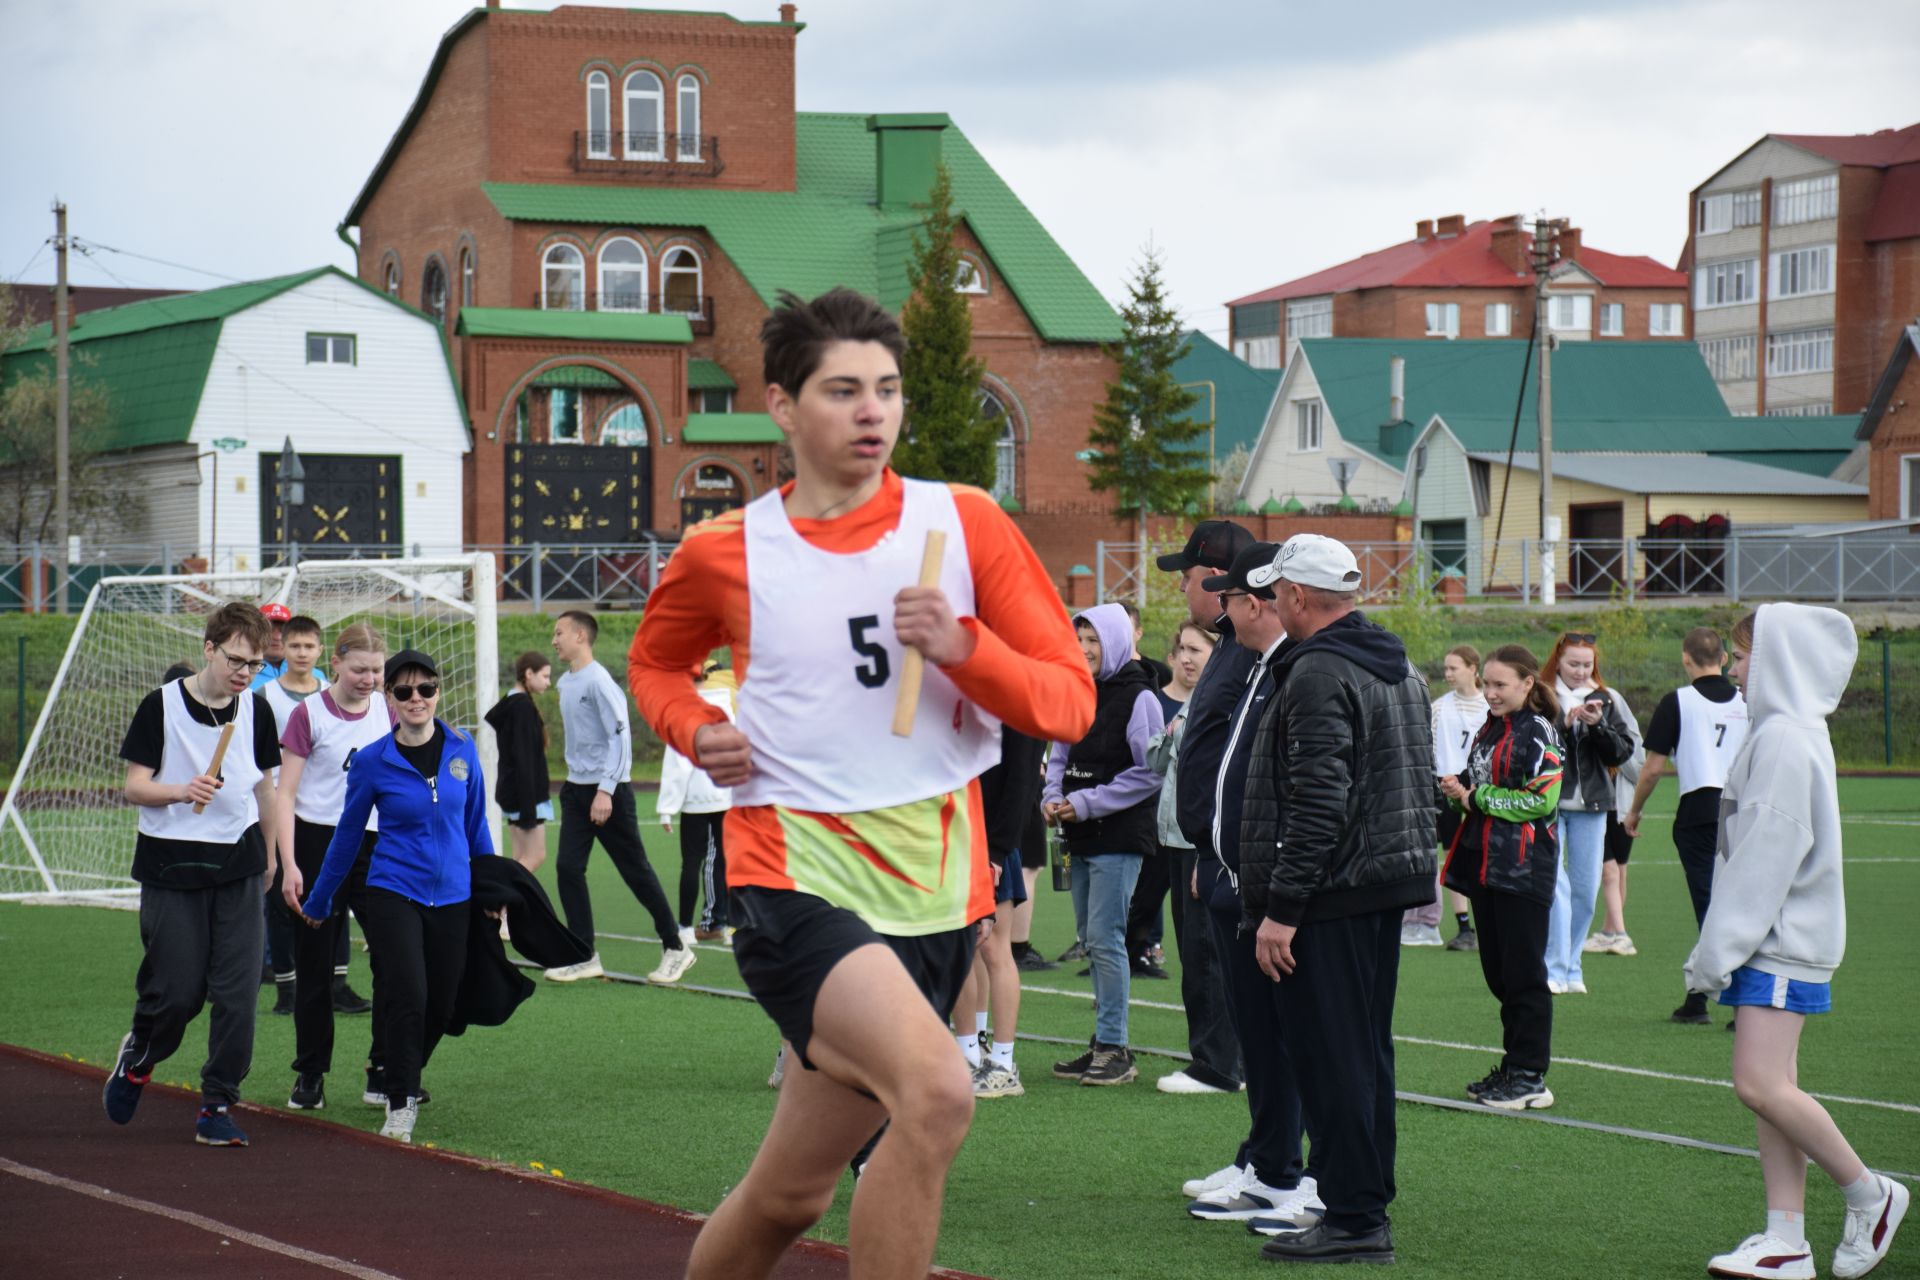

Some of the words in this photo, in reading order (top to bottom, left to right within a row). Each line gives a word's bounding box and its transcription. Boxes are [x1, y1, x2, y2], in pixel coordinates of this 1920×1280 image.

[848, 614, 891, 689] 5
[1461, 730, 1470, 750] 7
[1714, 723, 1727, 748] 7
